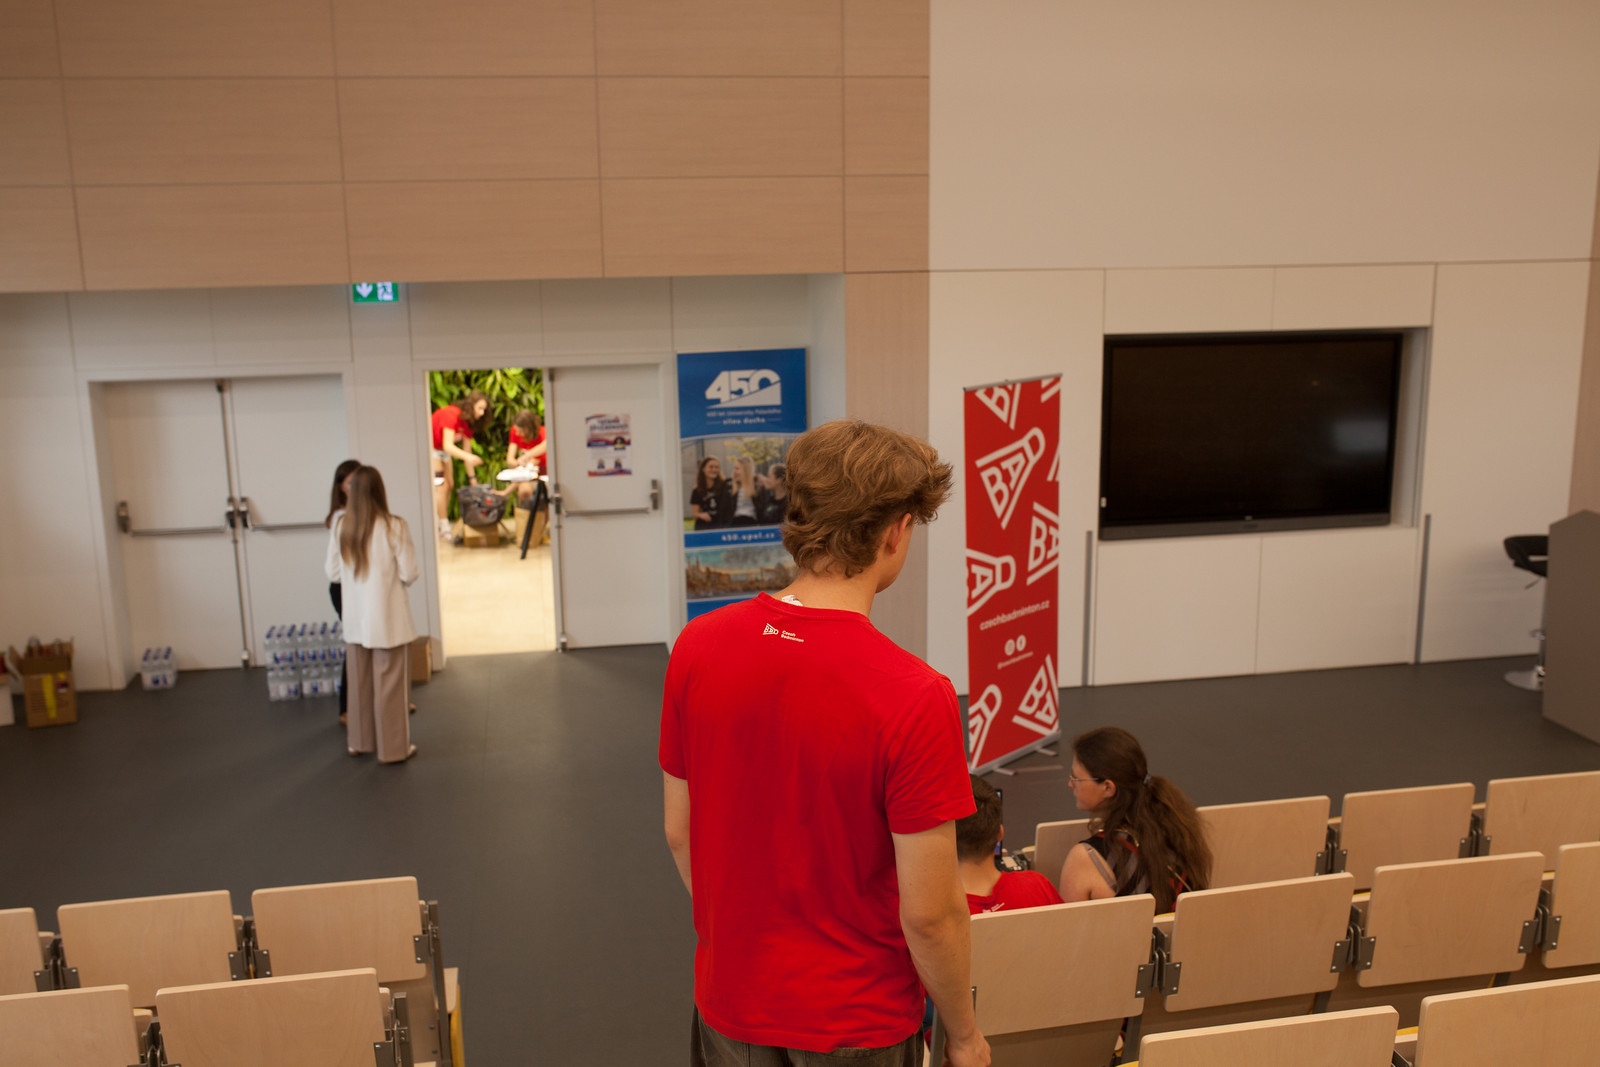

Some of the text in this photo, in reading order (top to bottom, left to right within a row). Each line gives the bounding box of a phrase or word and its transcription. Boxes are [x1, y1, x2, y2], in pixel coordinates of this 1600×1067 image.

[705, 369, 782, 406] 450
[975, 427, 1046, 530] BAD
[1027, 501, 1059, 585] BA
[966, 548, 1016, 617] AD
[979, 600, 1050, 632] czechbadminton.cz
[1012, 653, 1058, 735] BA
